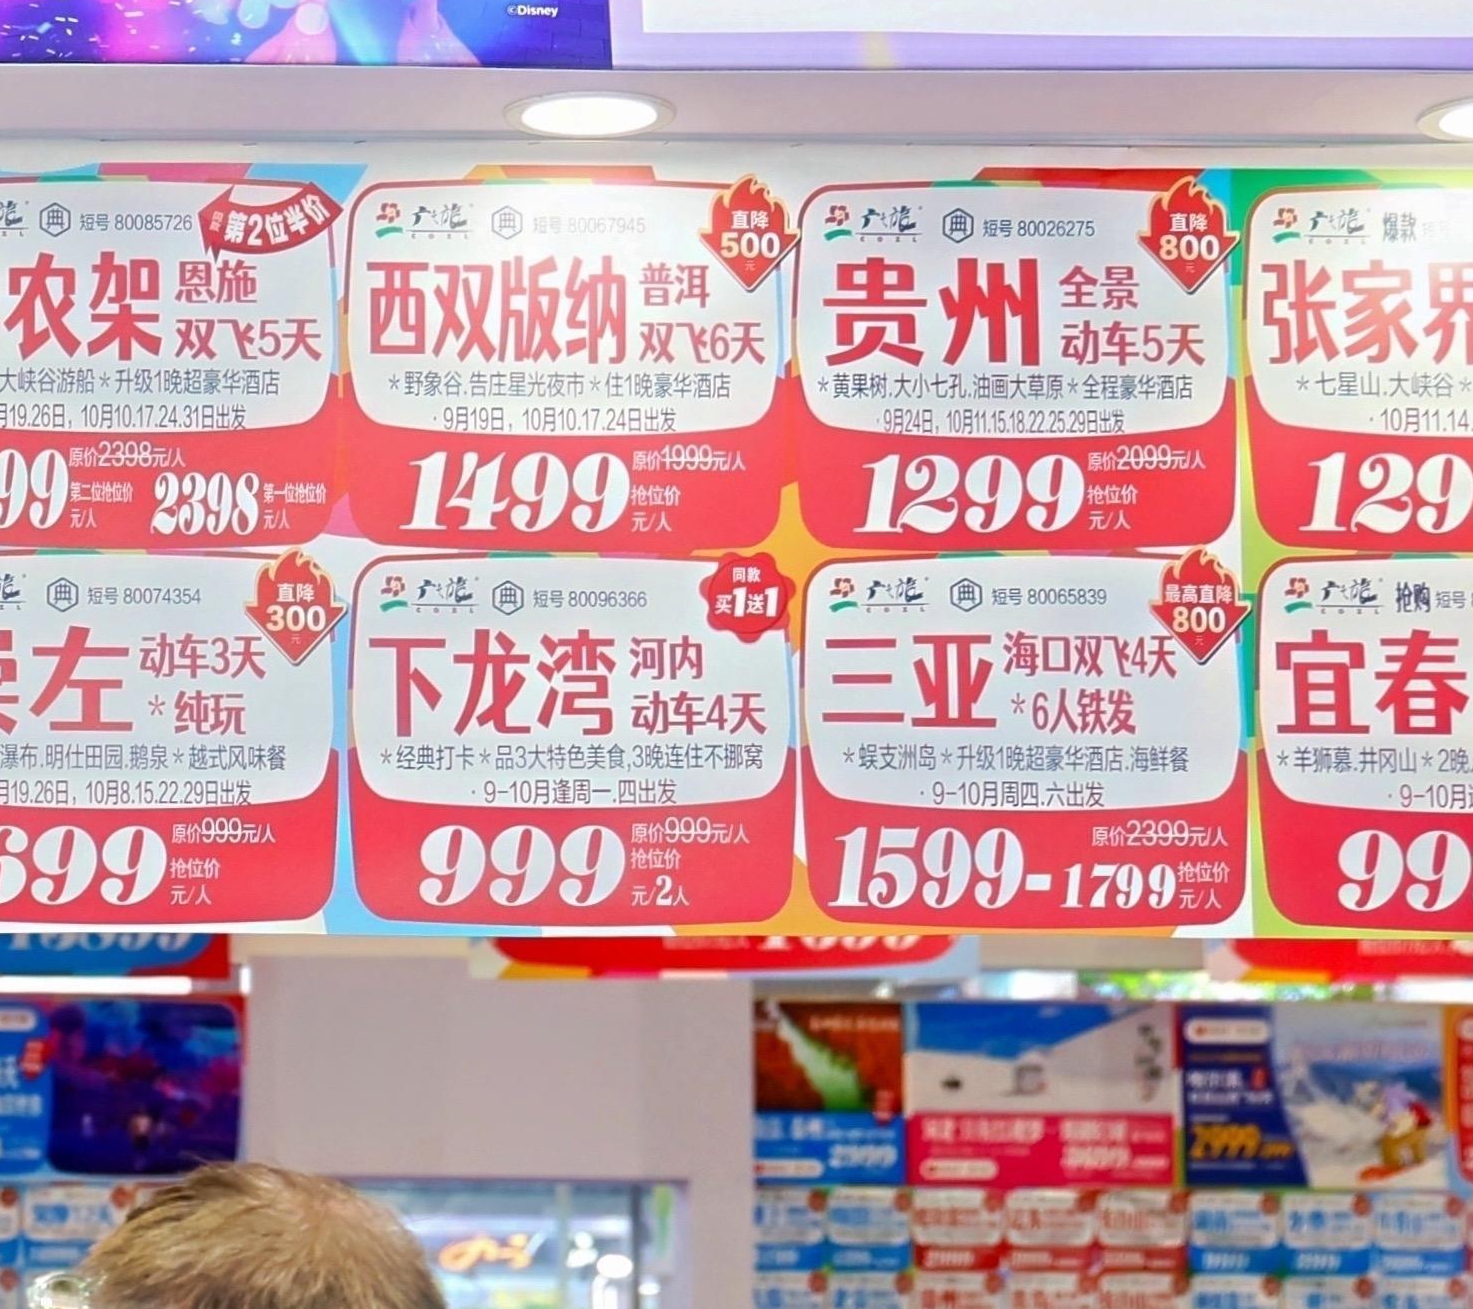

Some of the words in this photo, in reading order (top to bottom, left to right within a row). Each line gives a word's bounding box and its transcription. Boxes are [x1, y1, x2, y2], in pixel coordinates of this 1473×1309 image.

[1018, 220, 1094, 237] 80026275
[1159, 235, 1219, 260] 800
[366, 255, 627, 364] 西双版纳
[823, 257, 1040, 367] 贵州
[1061, 321, 1204, 366] 动车5天
[151, 472, 259, 535] 2398
[400, 451, 630, 532] 1499
[854, 454, 1083, 534] 1299
[123, 588, 201, 604] 80074354
[568, 590, 647, 608] 80096366
[369, 628, 616, 736] 下龙湾
[823, 633, 997, 728] 三亚
[1003, 630, 1177, 678] 海口双飞4天
[1275, 628, 1470, 736] 宜春
[419, 825, 625, 906] 999
